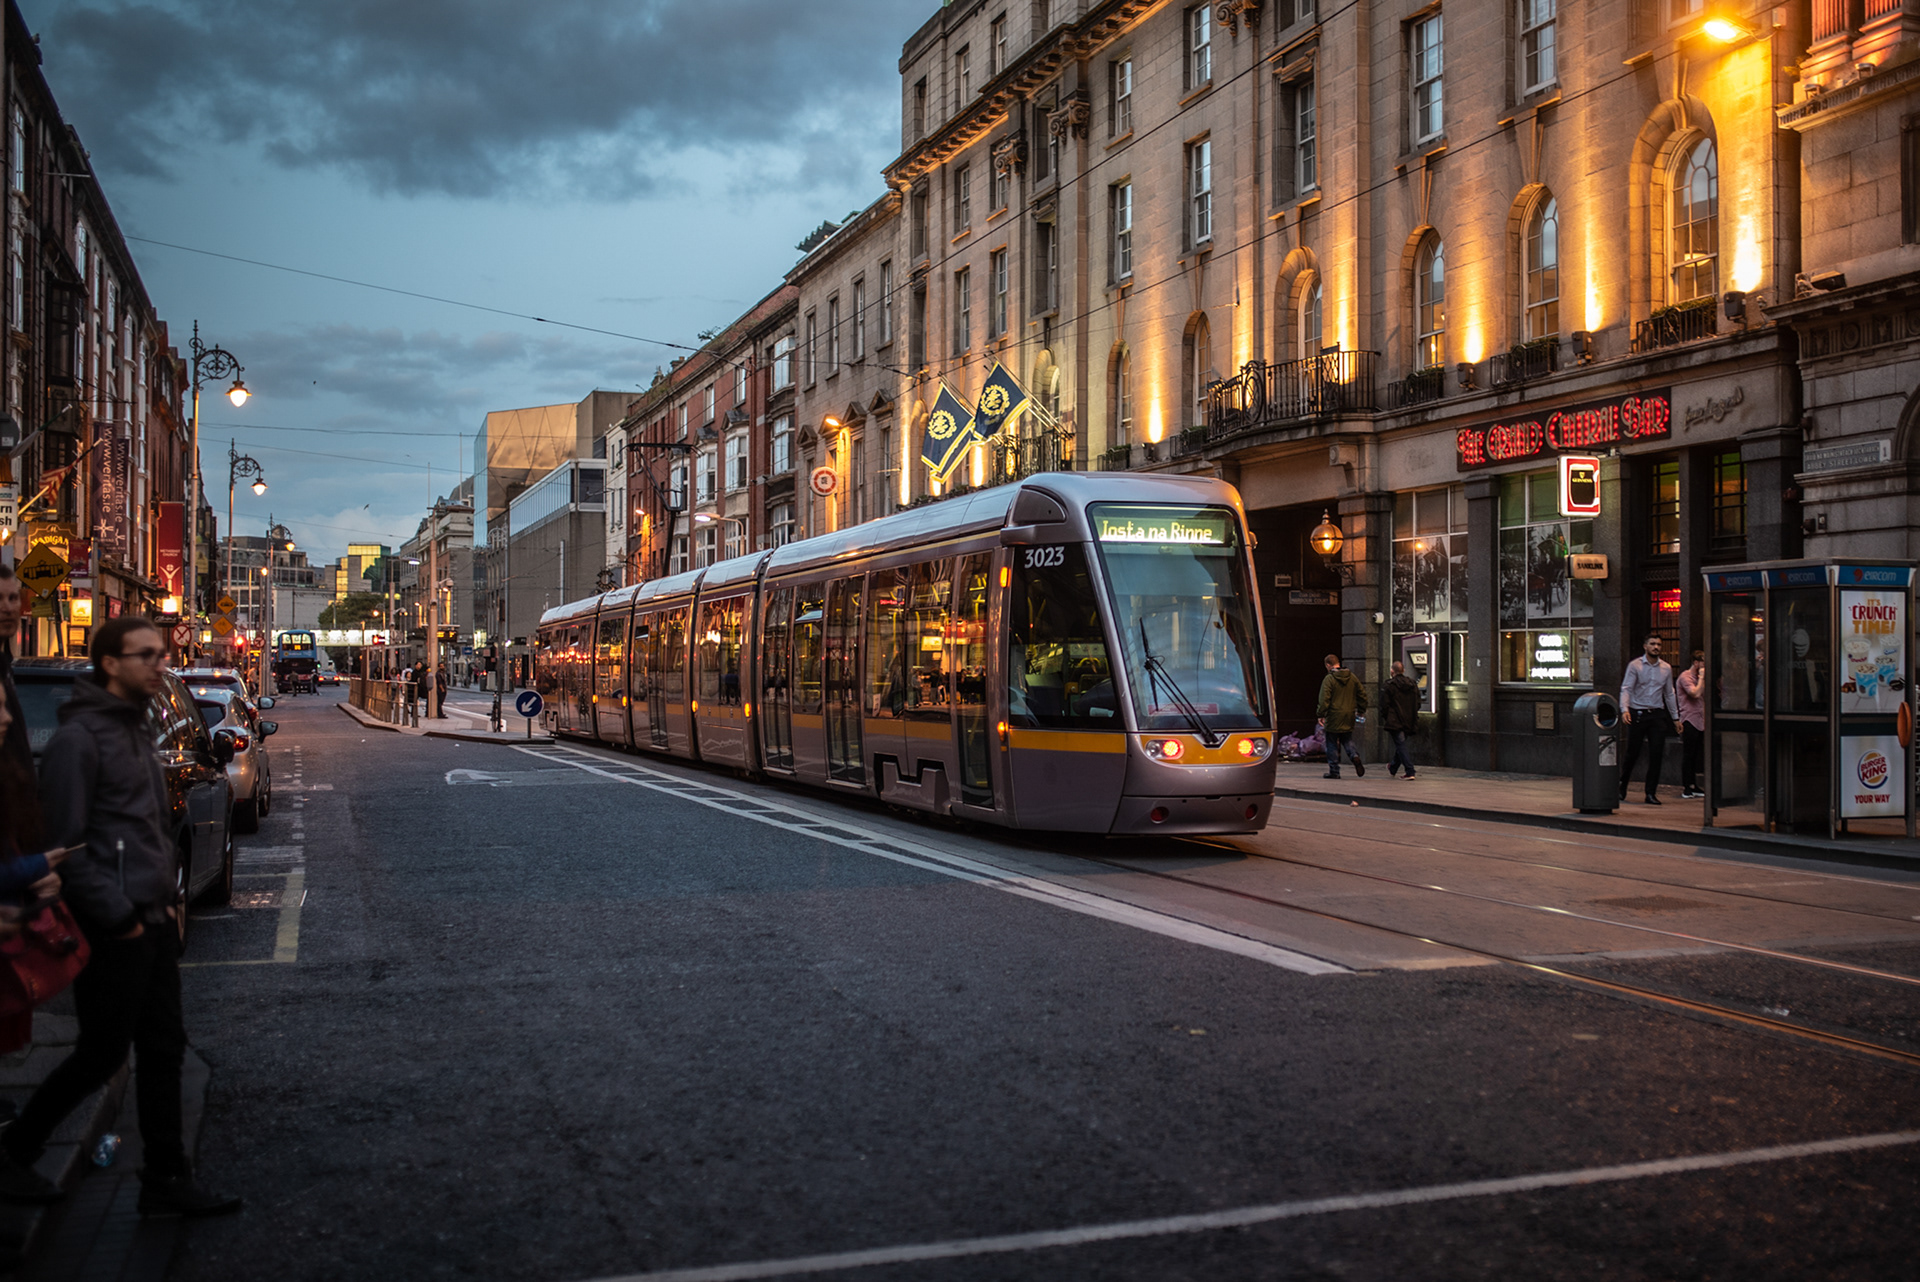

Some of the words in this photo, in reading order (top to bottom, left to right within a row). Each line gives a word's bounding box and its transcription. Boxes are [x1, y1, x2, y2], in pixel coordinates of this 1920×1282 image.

[102, 426, 113, 513] www.veritas.ie
[1829, 458, 1853, 468] STREET
[114, 441, 125, 523] www.veritas.ie
[1148, 527, 1167, 540] na
[1171, 522, 1213, 540] Rinne
[1024, 546, 1065, 569] 3023
[1867, 598, 1881, 606] IT'S
[1852, 605, 1896, 621] CRUNCH
[1852, 620, 1896, 635] TIME!
[1860, 756, 1886, 772] BURGER
[1862, 764, 1887, 781] KING
[1854, 794, 1873, 804] YOUR
[1874, 794, 1891, 803] WAY
